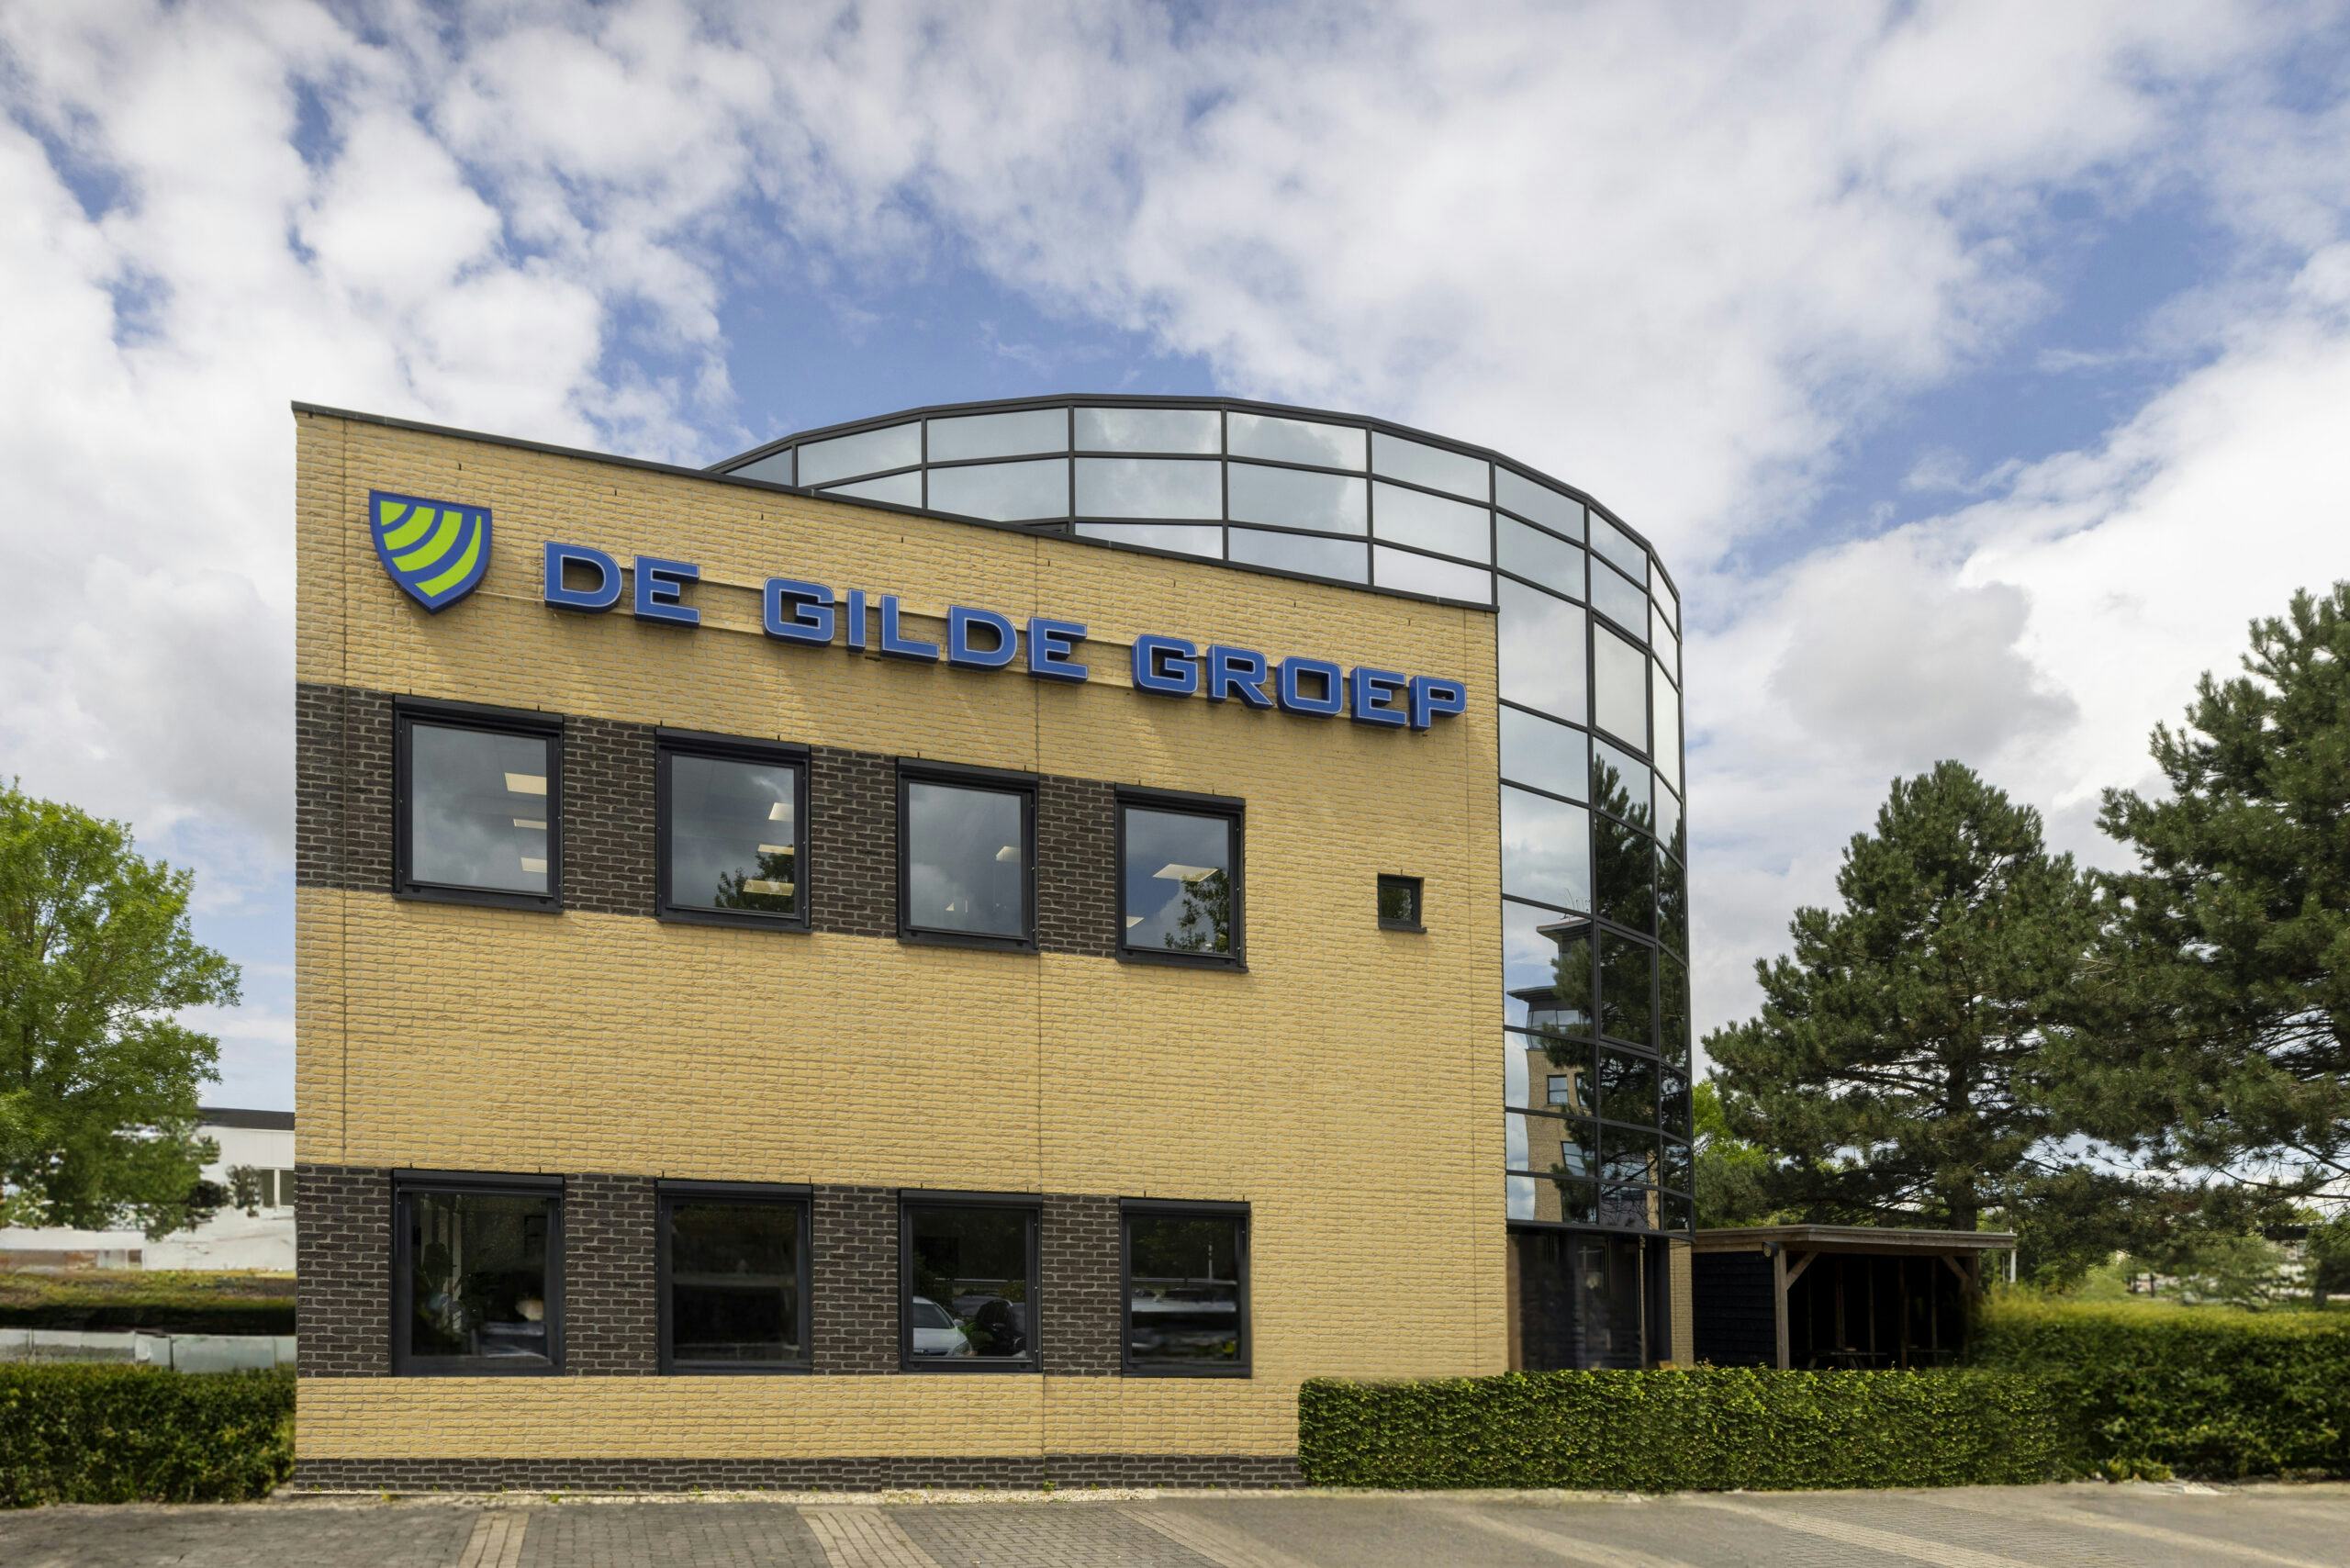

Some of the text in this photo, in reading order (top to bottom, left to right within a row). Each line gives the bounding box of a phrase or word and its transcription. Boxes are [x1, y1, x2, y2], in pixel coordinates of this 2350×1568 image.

[543, 541, 1467, 731] DE GILDE GROEP
